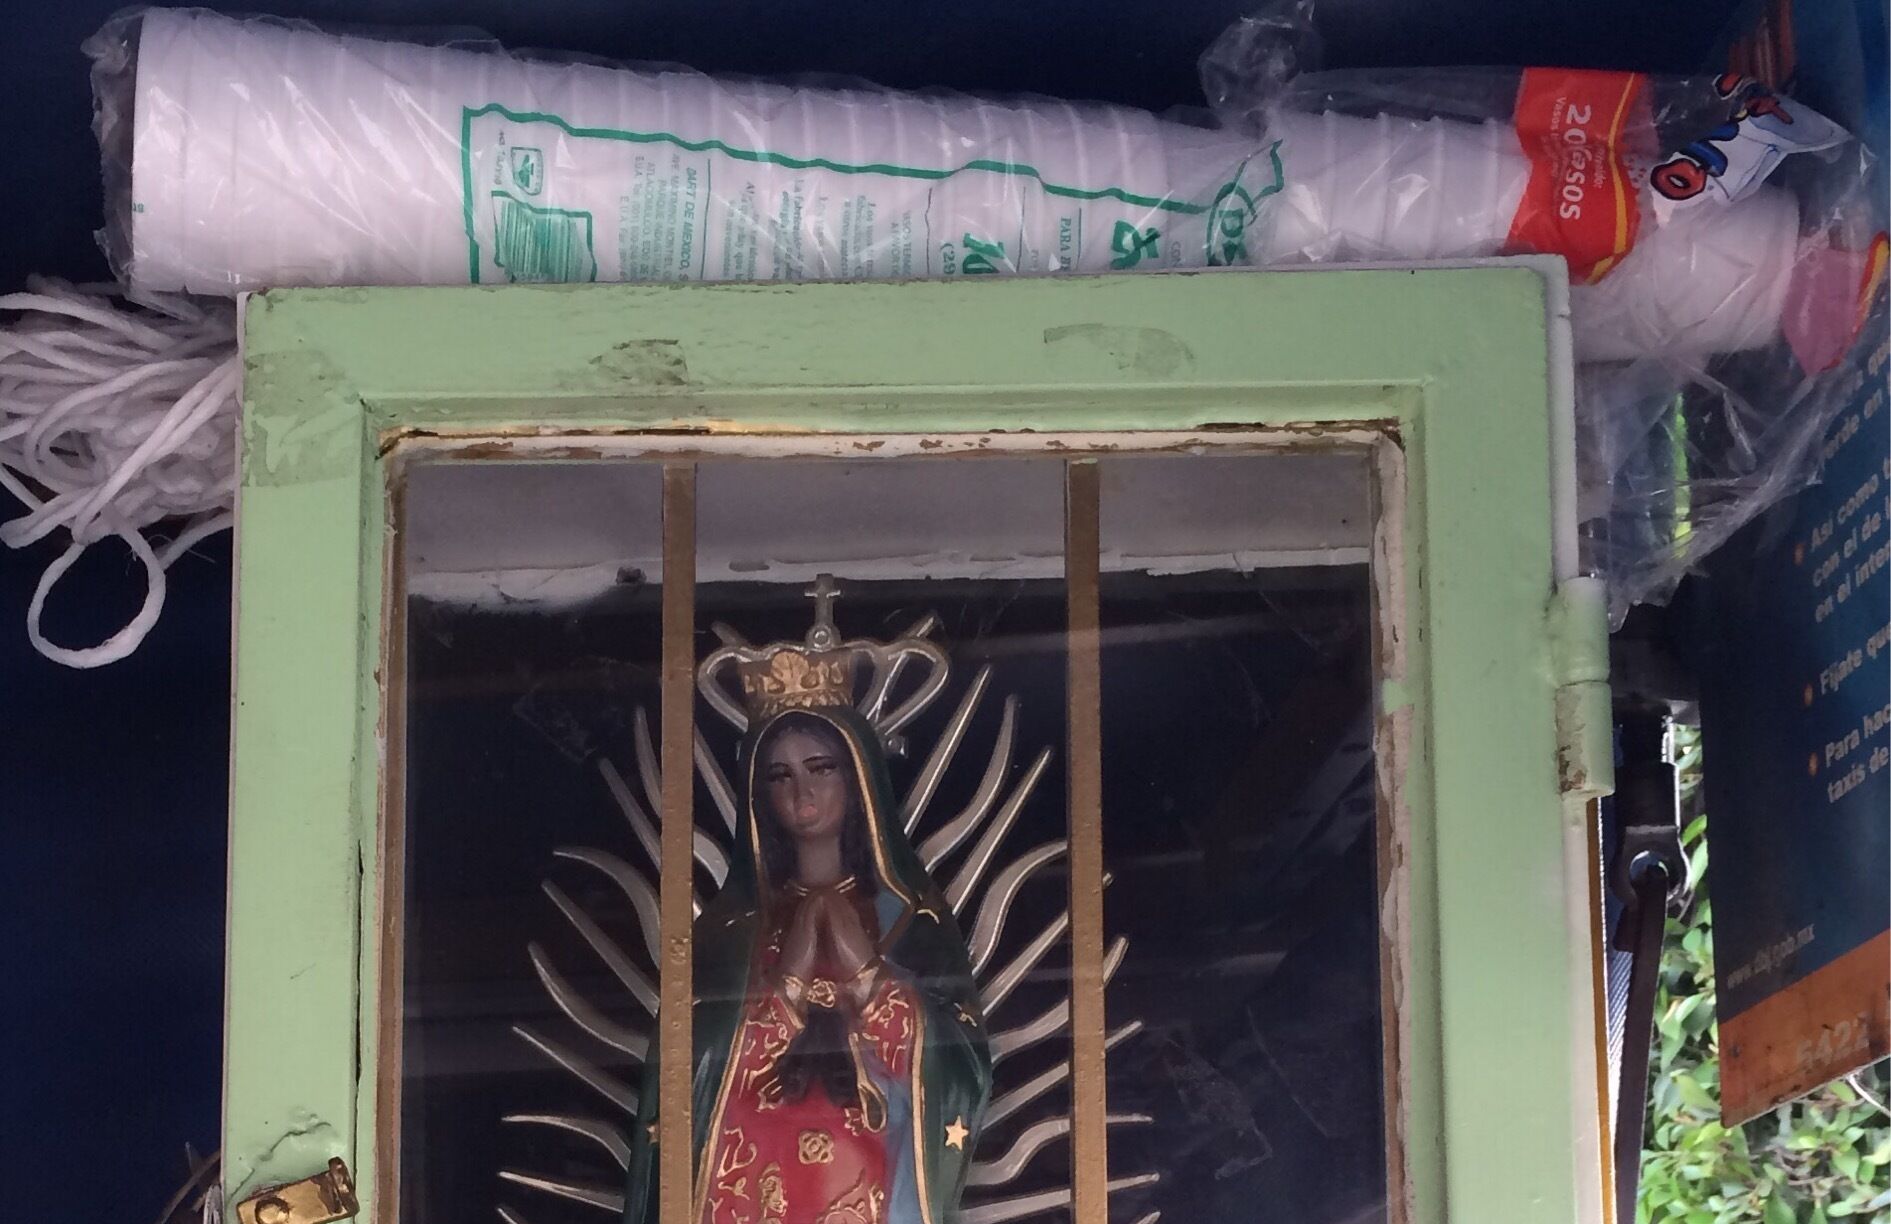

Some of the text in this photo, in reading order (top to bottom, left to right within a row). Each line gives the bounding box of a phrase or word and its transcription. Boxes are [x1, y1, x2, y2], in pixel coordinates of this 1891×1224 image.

[655, 179, 668, 220] PARQUE
[667, 175, 680, 225] MAXIMINO
[686, 167, 698, 200] DART
[684, 201, 695, 219] DE
[1059, 216, 1073, 252] PARA
[680, 221, 694, 271] MEXICO,
[1837, 472, 1879, 525] como
[1812, 511, 1882, 588] con el de
[1814, 594, 1834, 624] en
[1836, 572, 1851, 604] el
[1824, 729, 1861, 769] Para
[1826, 746, 1890, 804] taxis de
